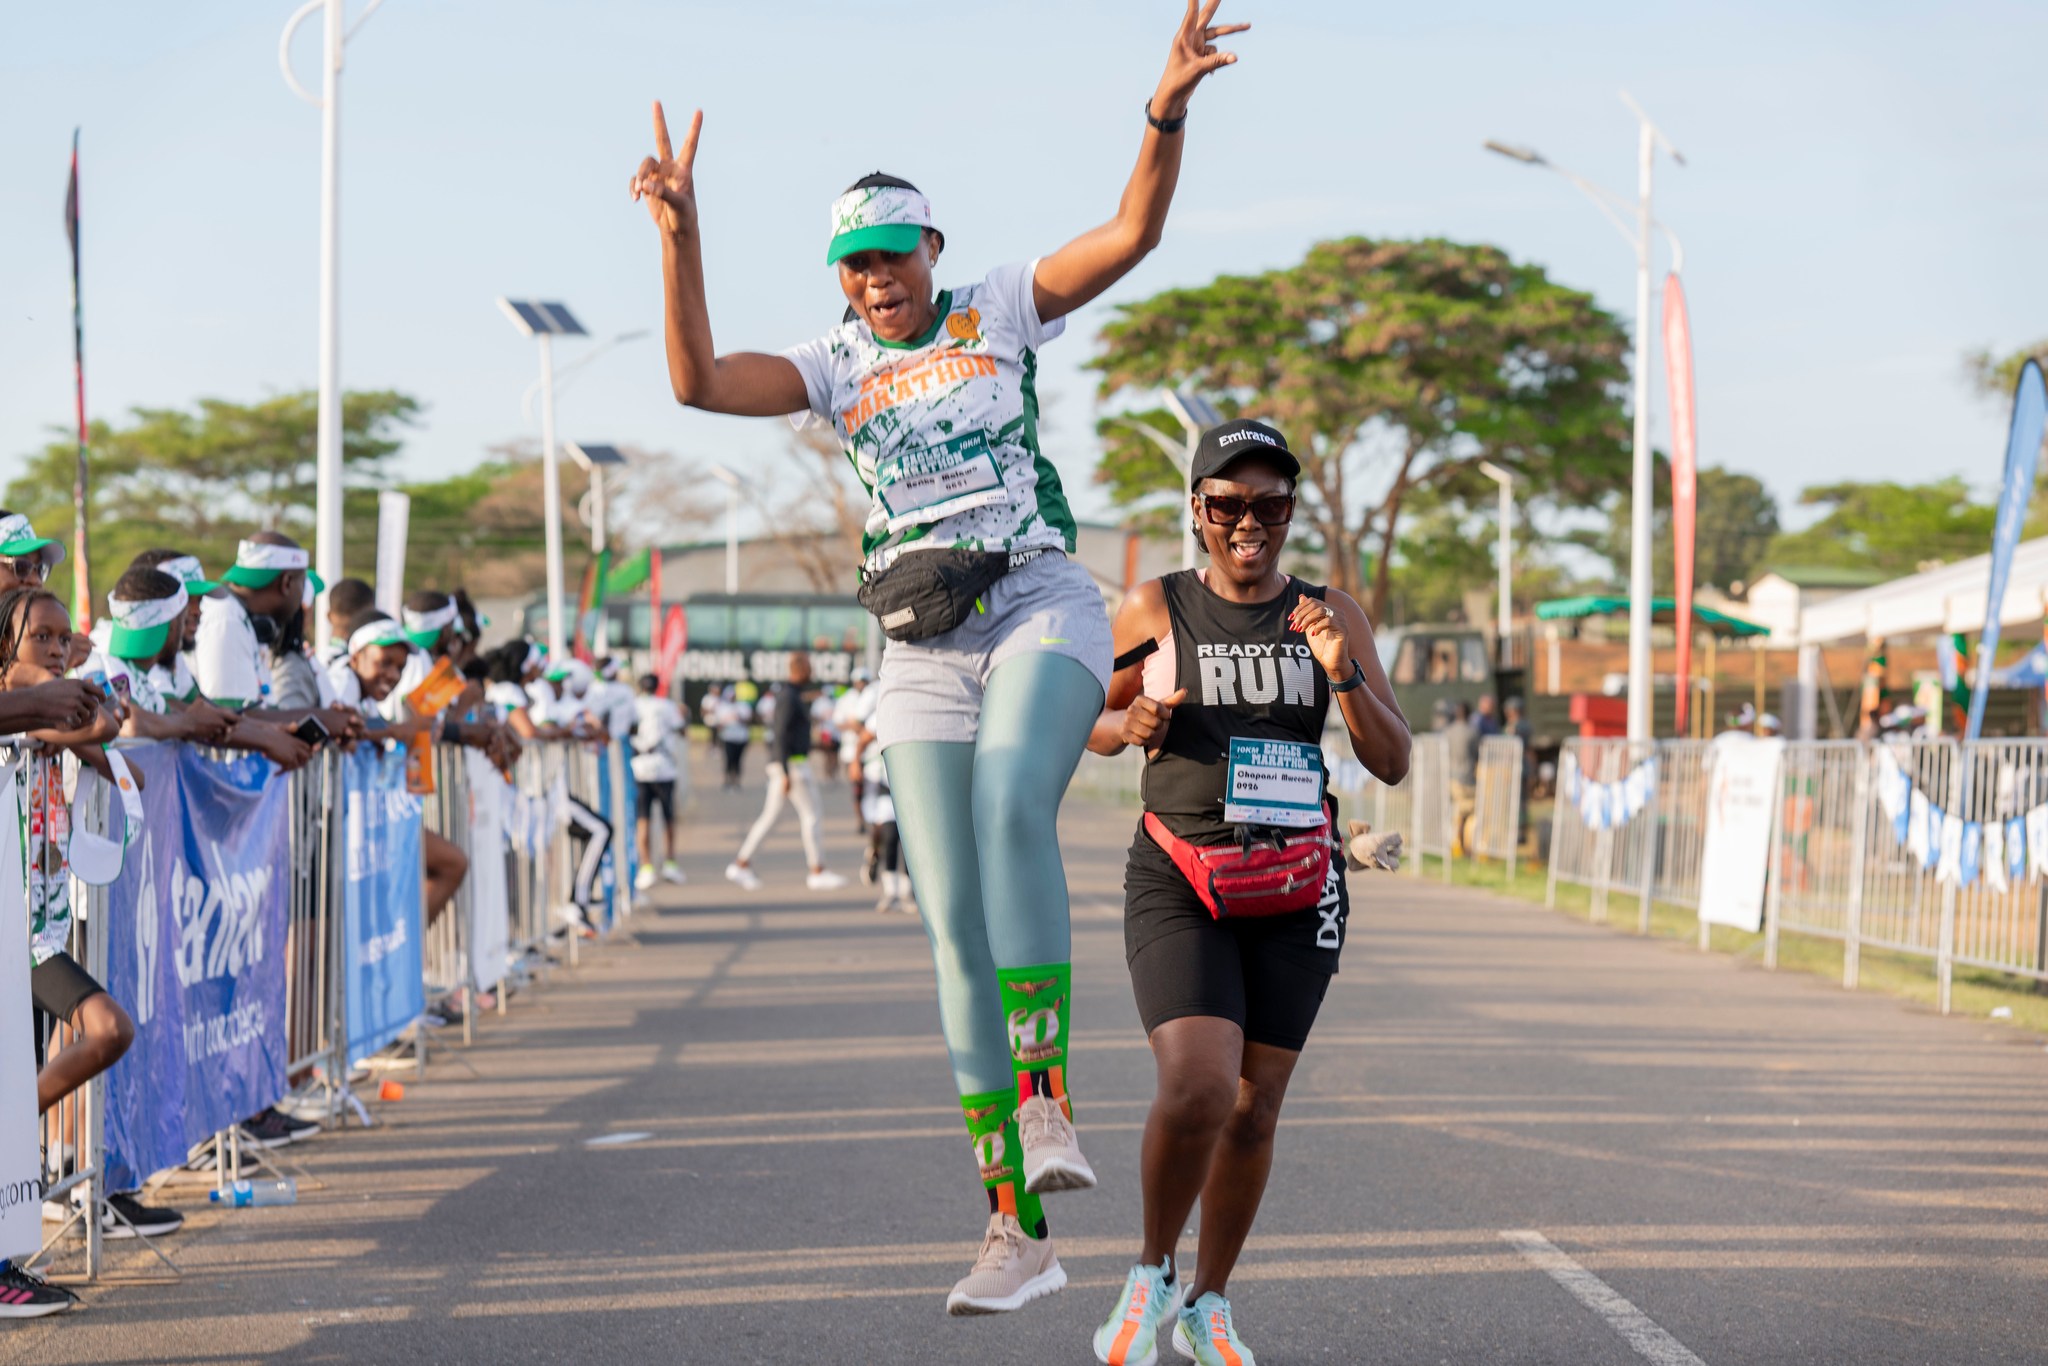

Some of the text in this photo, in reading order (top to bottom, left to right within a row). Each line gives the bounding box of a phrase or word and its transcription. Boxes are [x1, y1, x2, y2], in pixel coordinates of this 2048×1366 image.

[841, 354, 998, 435] MARATHON
[959, 436, 981, 450] 10KM
[1219, 429, 1277, 447] Emirates
[1197, 643, 1311, 658] READY TO
[1199, 656, 1315, 707] RUN
[1237, 746, 1259, 754] 10KM
[1263, 743, 1302, 757] EAGLES
[1251, 754, 1309, 770] MARATHON
[1236, 782, 1259, 791] 0926
[1008, 1007, 1060, 1060] 60
